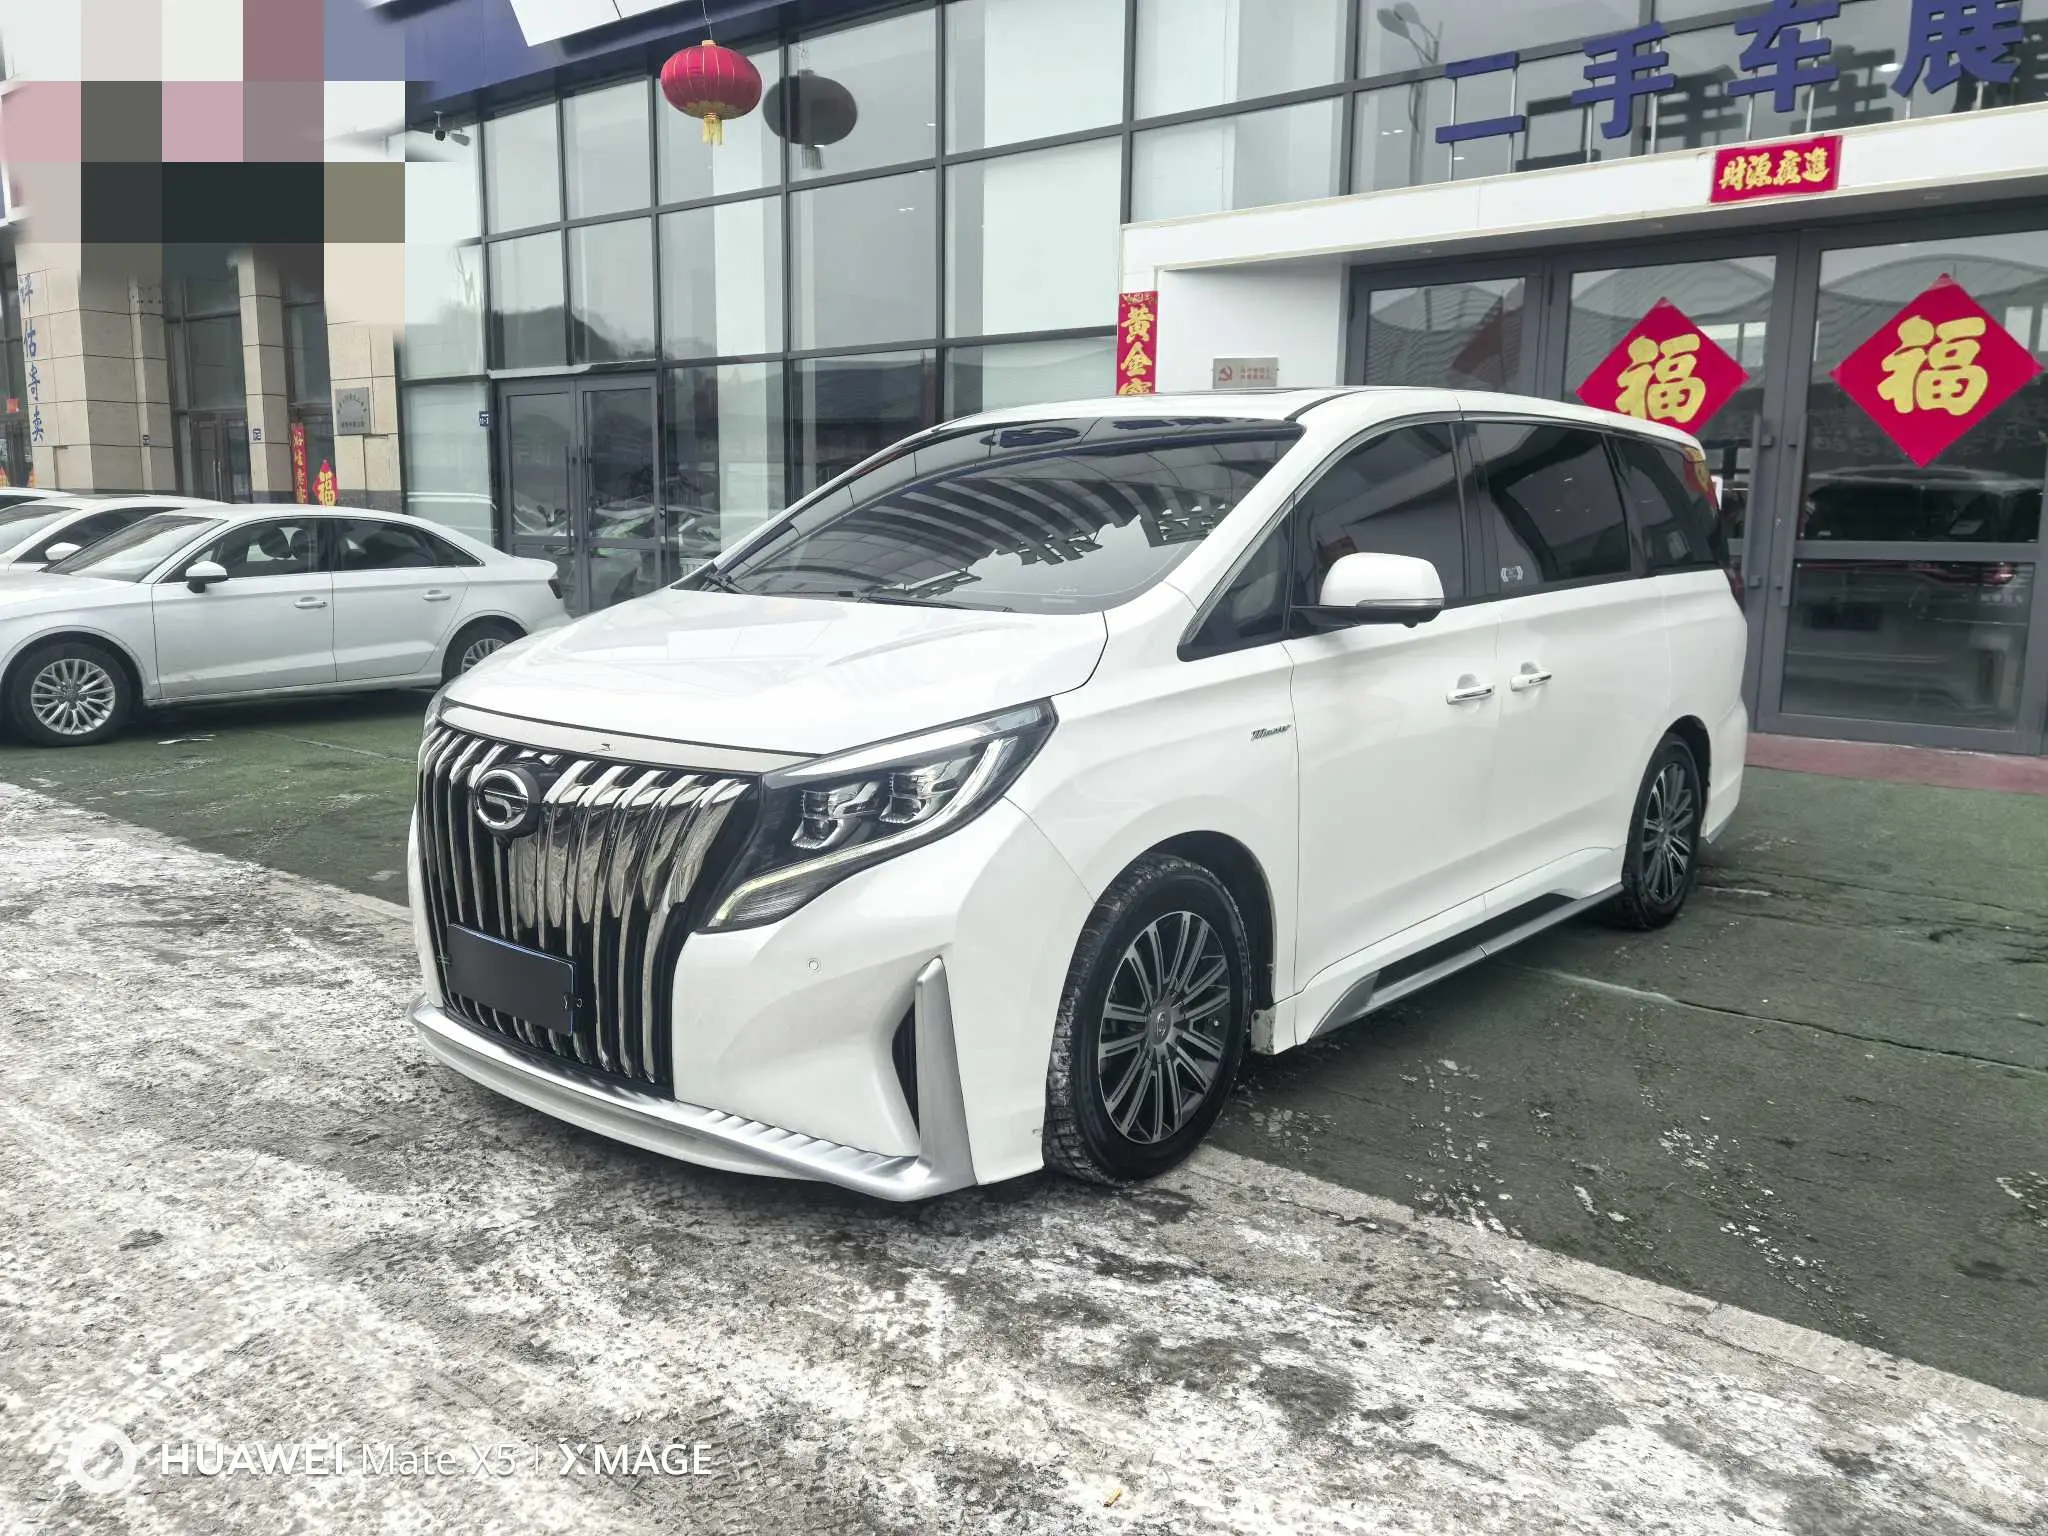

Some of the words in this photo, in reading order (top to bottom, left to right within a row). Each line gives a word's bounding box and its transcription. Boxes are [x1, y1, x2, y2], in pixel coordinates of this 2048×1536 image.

[1435, 0, 2023, 143] 二手车展
[1616, 333, 1706, 423] 福
[1877, 316, 1988, 415] 福
[317, 471, 336, 505] 福
